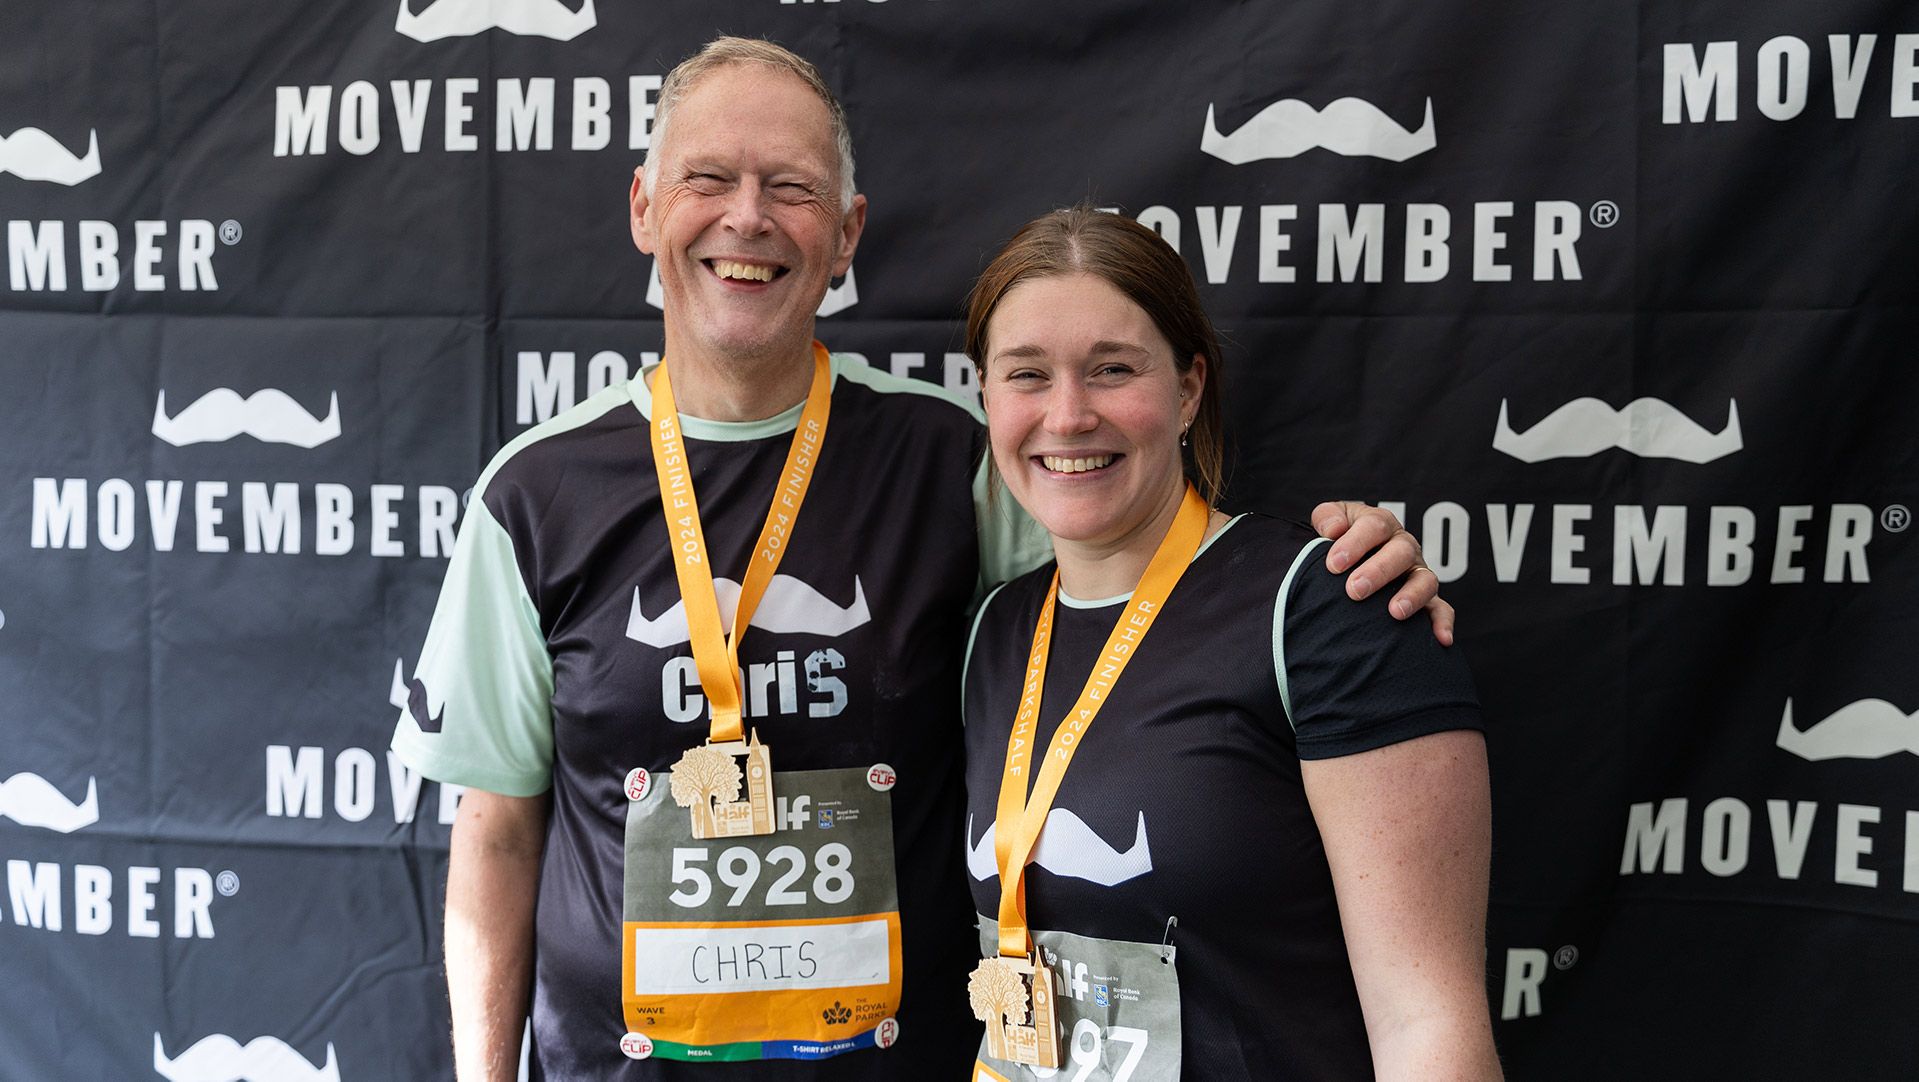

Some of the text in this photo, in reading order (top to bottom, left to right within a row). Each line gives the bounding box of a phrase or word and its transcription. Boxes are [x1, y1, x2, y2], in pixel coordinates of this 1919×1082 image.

[274, 75, 662, 157] MOVEMBE
[659, 416, 701, 565] 2024 FINISHER
[761, 419, 820, 562] 2024 FINISHER
[662, 648, 849, 723] CriS
[1055, 600, 1157, 761] 2024 FINISHER
[776, 795, 811, 831] lf
[668, 842, 855, 908] 5928
[1620, 797, 1919, 894] MOVE
[692, 941, 817, 984] CHRIS
[636, 1006, 665, 1014] WAVE
[646, 1017, 656, 1025] 3
[855, 1003, 888, 1013] ROYAL
[687, 1049, 713, 1057] MEDAL
[792, 1045, 819, 1054] T-SHIRT
[1030, 1018, 1149, 1082] 97
